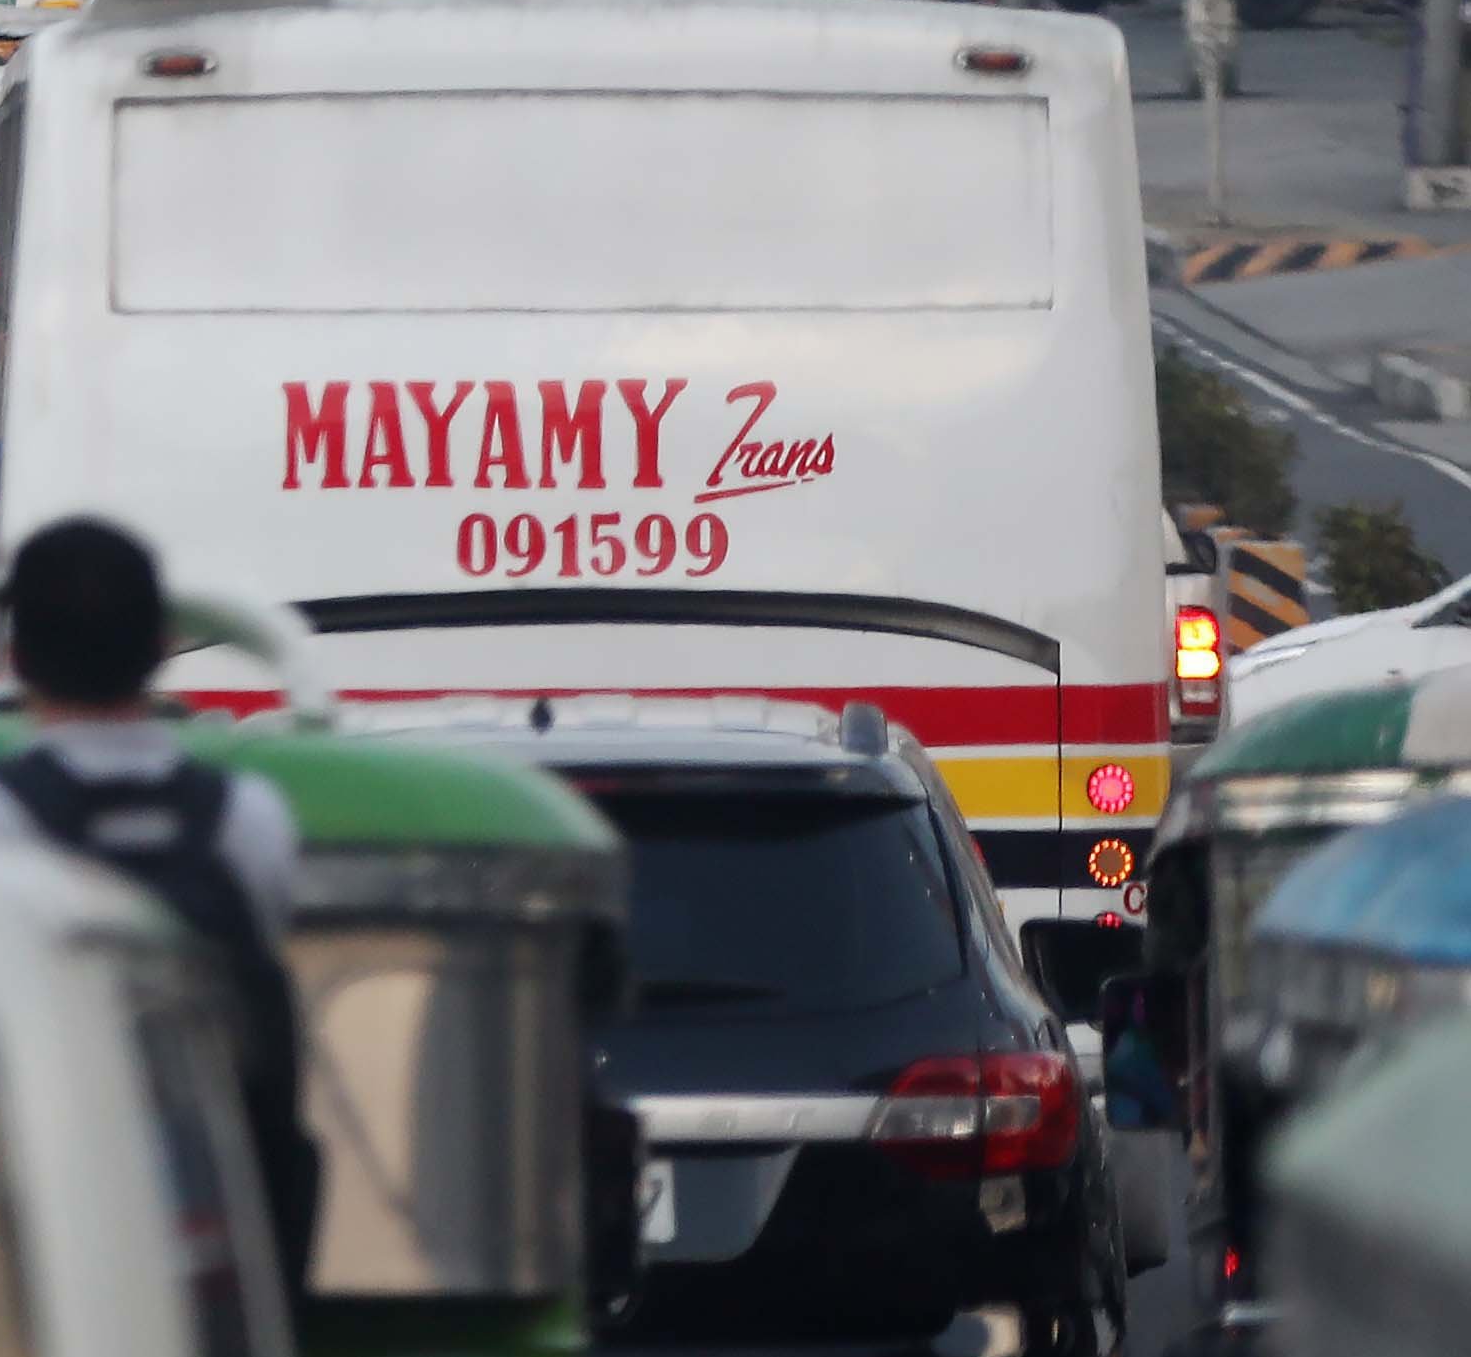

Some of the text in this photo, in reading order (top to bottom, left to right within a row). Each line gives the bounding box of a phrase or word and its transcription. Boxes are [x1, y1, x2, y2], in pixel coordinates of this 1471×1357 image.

[282, 378, 837, 492] MAYAMY Trans
[456, 511, 730, 579] 091599
